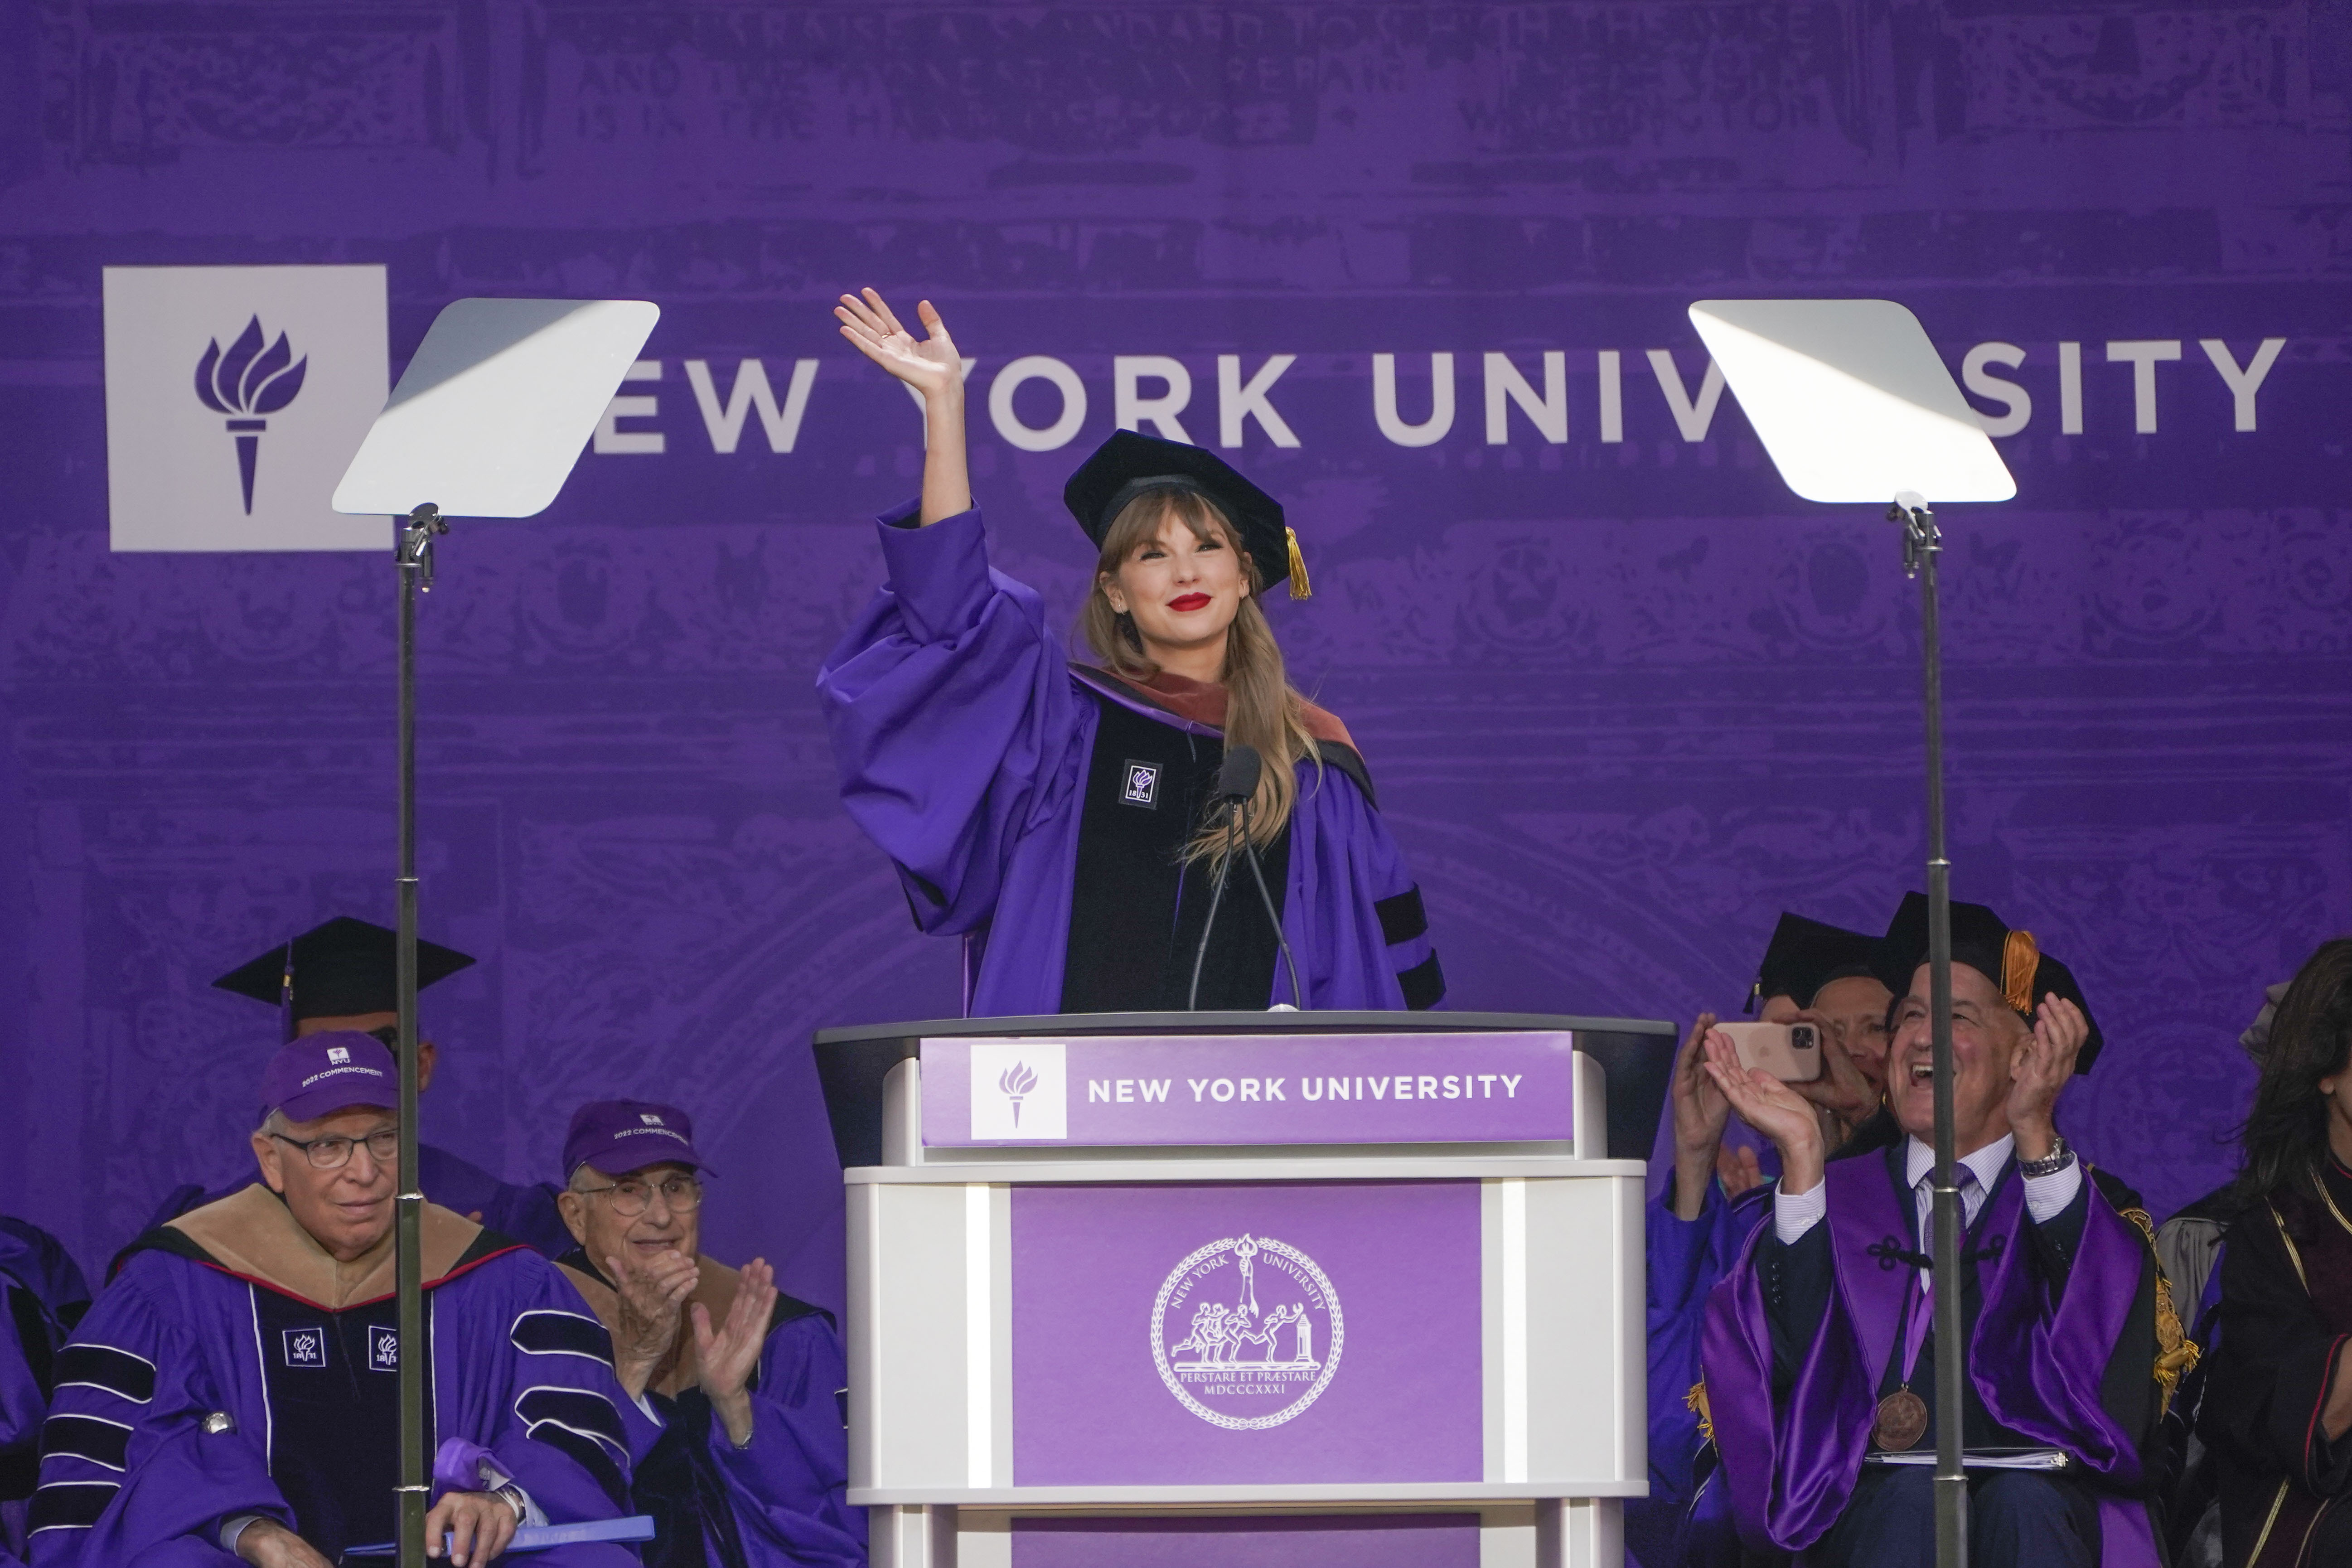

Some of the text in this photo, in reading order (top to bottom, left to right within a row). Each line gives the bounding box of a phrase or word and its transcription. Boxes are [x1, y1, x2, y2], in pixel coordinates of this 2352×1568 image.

[593, 358, 819, 454] EW
[1372, 338, 2287, 448] UNIVSITY
[302, 1067, 383, 1088] 2022 COMMENCEMENT
[1088, 1074, 1523, 1103] NEW YORK UNIVERSITY
[614, 1128, 688, 1146] 2022 COMMENC
[1171, 1253, 1326, 1311] NEW YORK UNIVERSITY
[1181, 1371, 1316, 1383] PERSTARE ET PRÆSTARE
[1204, 1384, 1285, 1395] MDCCCXXXI
